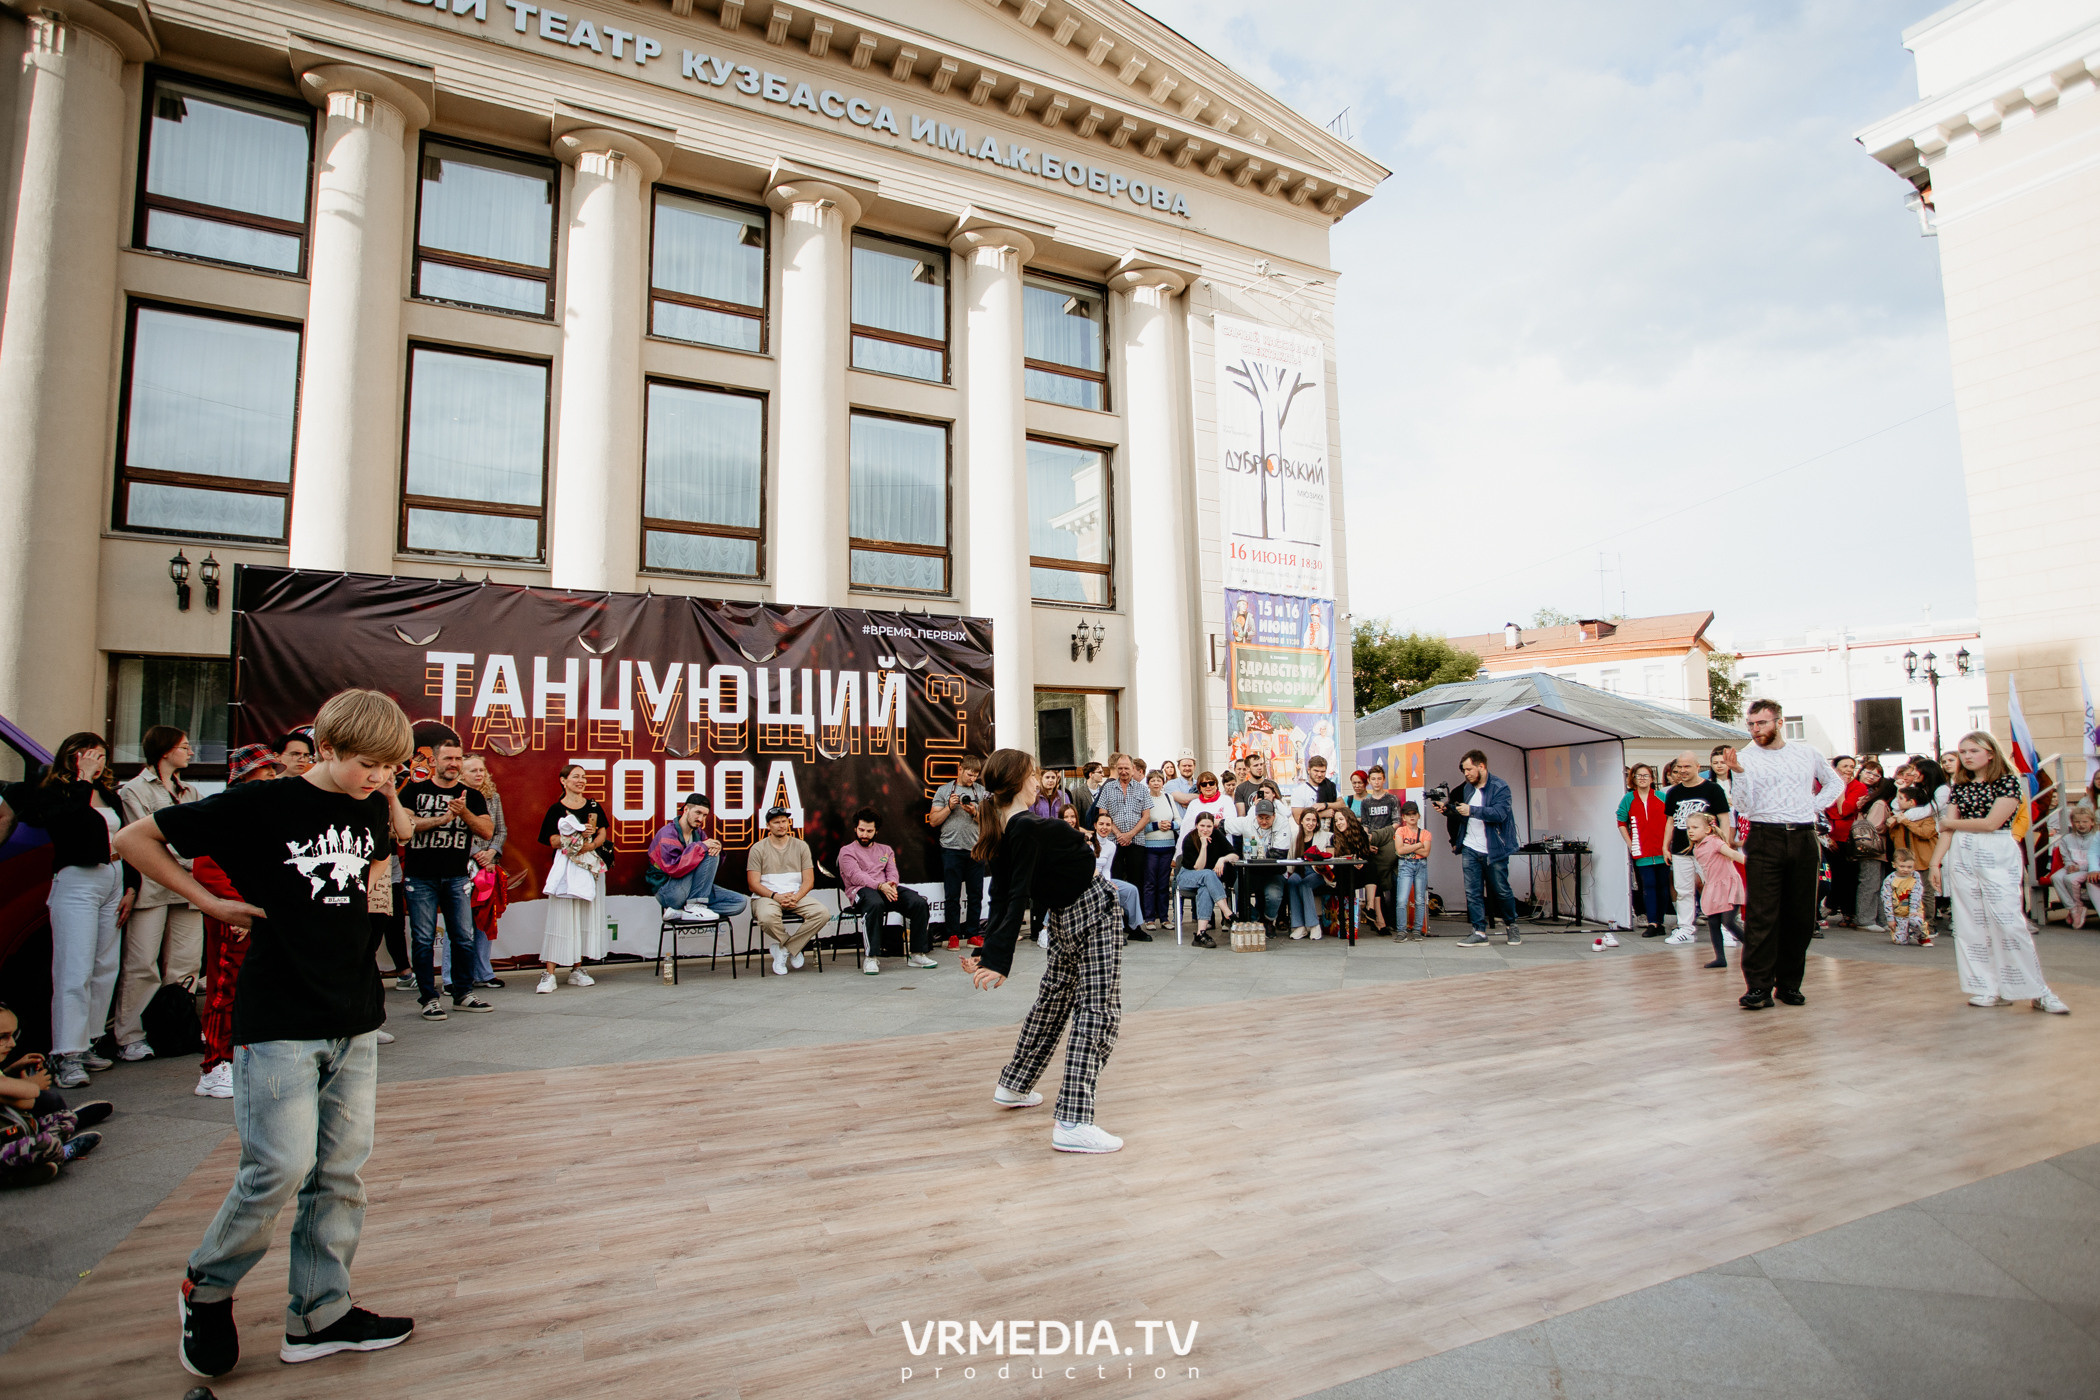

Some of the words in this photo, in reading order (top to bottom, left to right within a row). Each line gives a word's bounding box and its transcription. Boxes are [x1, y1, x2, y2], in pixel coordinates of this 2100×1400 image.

[504, 0, 662, 65] ТЕАТР
[681, 48, 899, 135] КУЗБАССА
[1229, 542, 1247, 560] 16
[1252, 549, 1297, 567] ИЮНЯ
[1301, 557, 1324, 571] 18:30
[1258, 600, 1272, 617] 15
[1286, 603, 1300, 620] 16
[862, 624, 967, 642] #ВРЕМЯ_ПЕРВЫХ
[1259, 619, 1297, 636] ИЮНЯ
[425, 651, 907, 736] ТАНЦУЮЩИЙ
